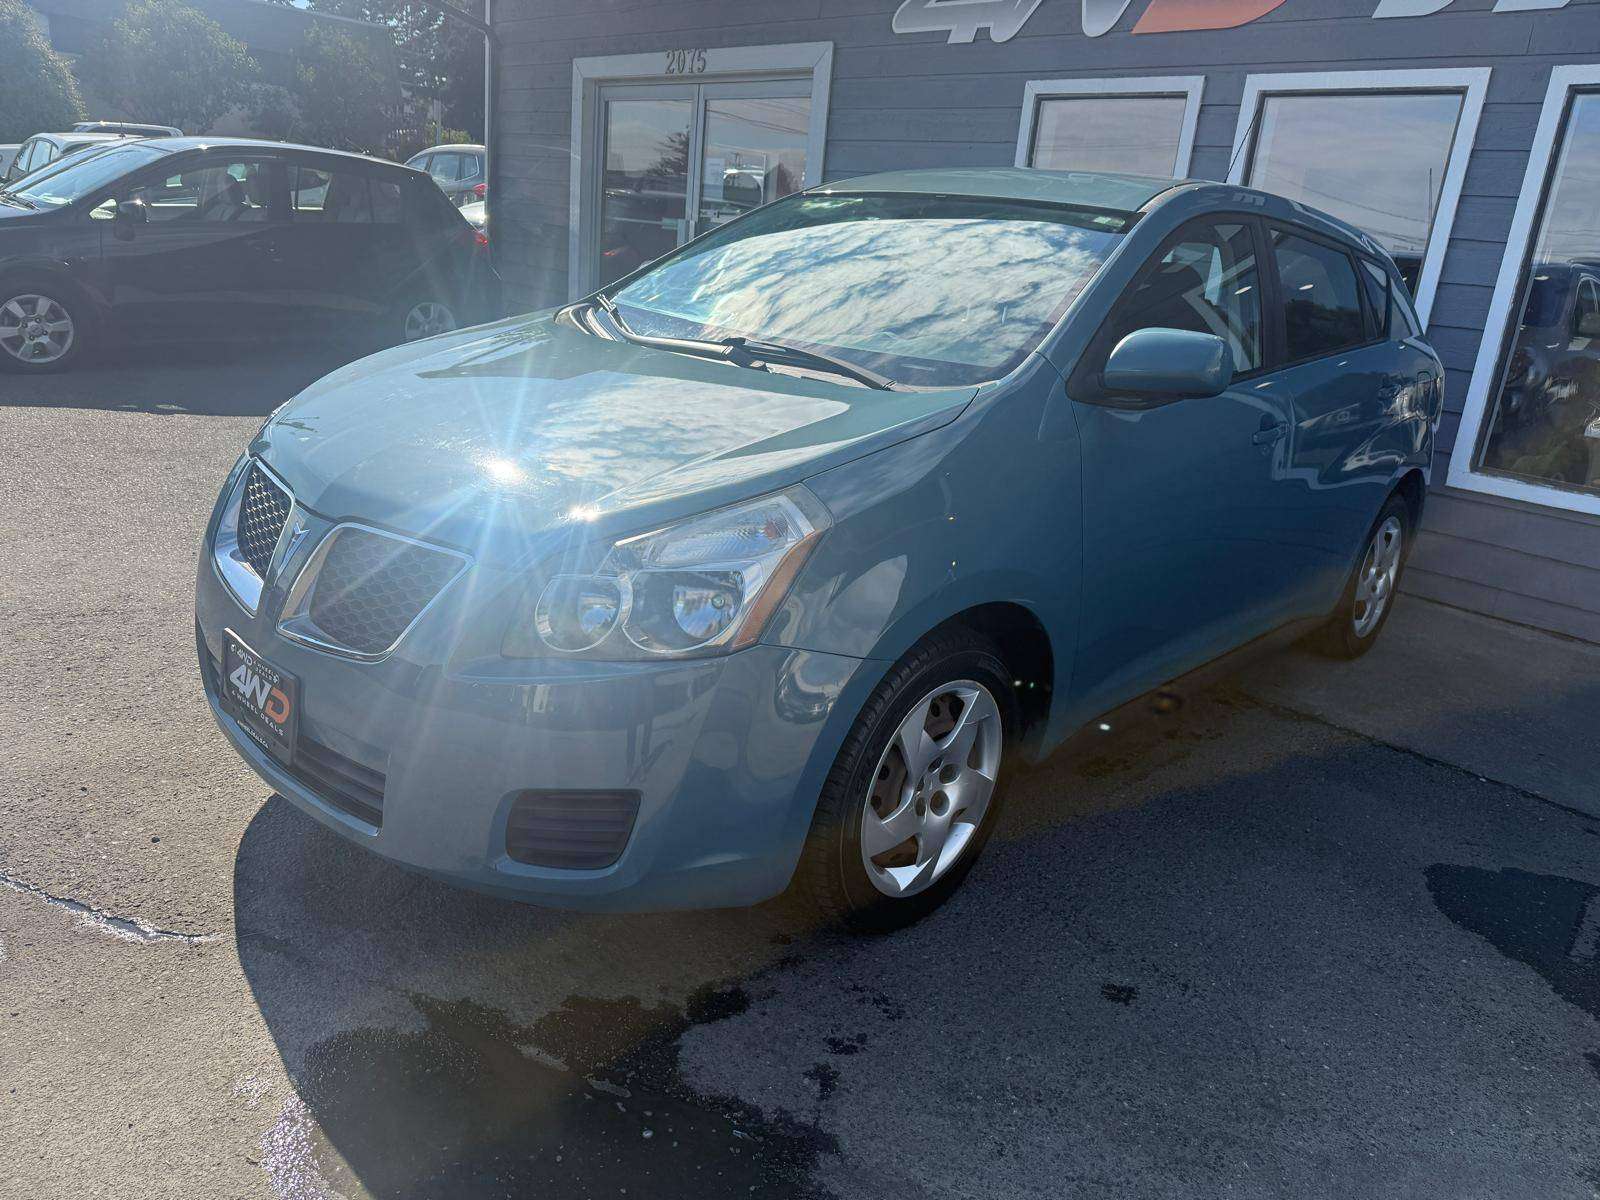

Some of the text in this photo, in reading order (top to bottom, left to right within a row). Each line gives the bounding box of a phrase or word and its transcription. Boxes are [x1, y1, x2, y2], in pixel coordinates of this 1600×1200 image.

[665, 48, 707, 74] 2075
[230, 664, 290, 723] 4WD
[237, 693, 258, 715] WHEEL
[260, 712, 284, 736] DEALS
